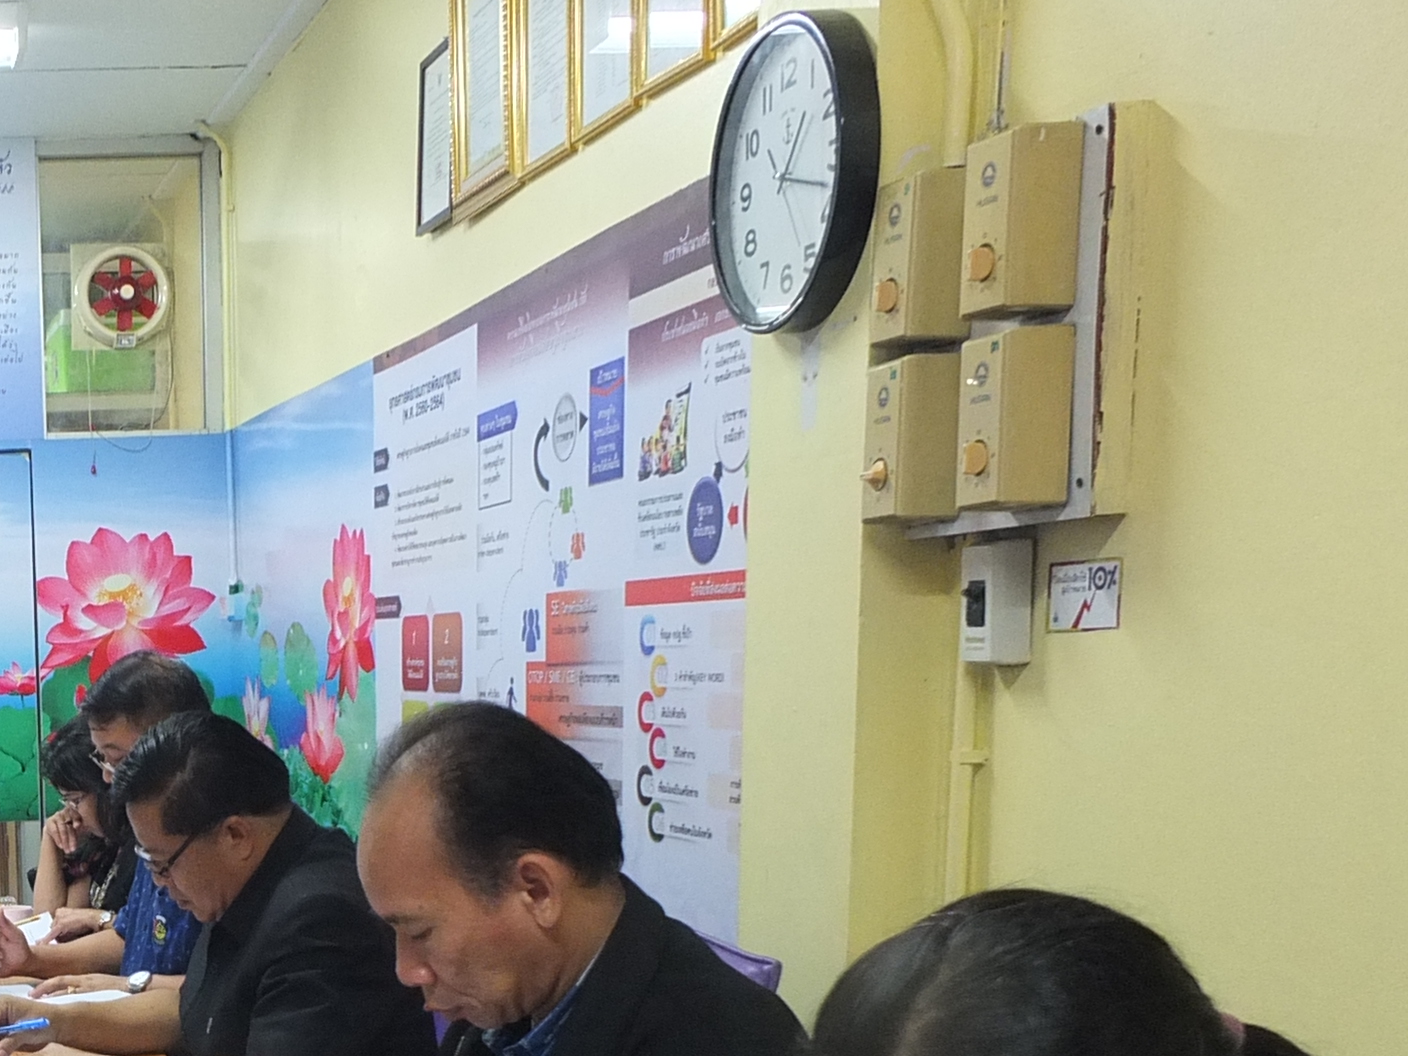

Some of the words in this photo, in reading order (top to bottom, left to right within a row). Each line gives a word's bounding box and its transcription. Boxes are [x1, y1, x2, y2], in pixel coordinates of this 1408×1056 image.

[780, 57, 797, 93] 12
[763, 84, 773, 116] 11
[822, 88, 835, 121] 2
[745, 129, 760, 161] 10
[740, 182, 752, 212] 9
[744, 228, 757, 258] 8
[803, 242, 816, 274] 5
[760, 260, 770, 290] 7
[780, 263, 794, 294] 6
[1087, 564, 1119, 592] 10%
